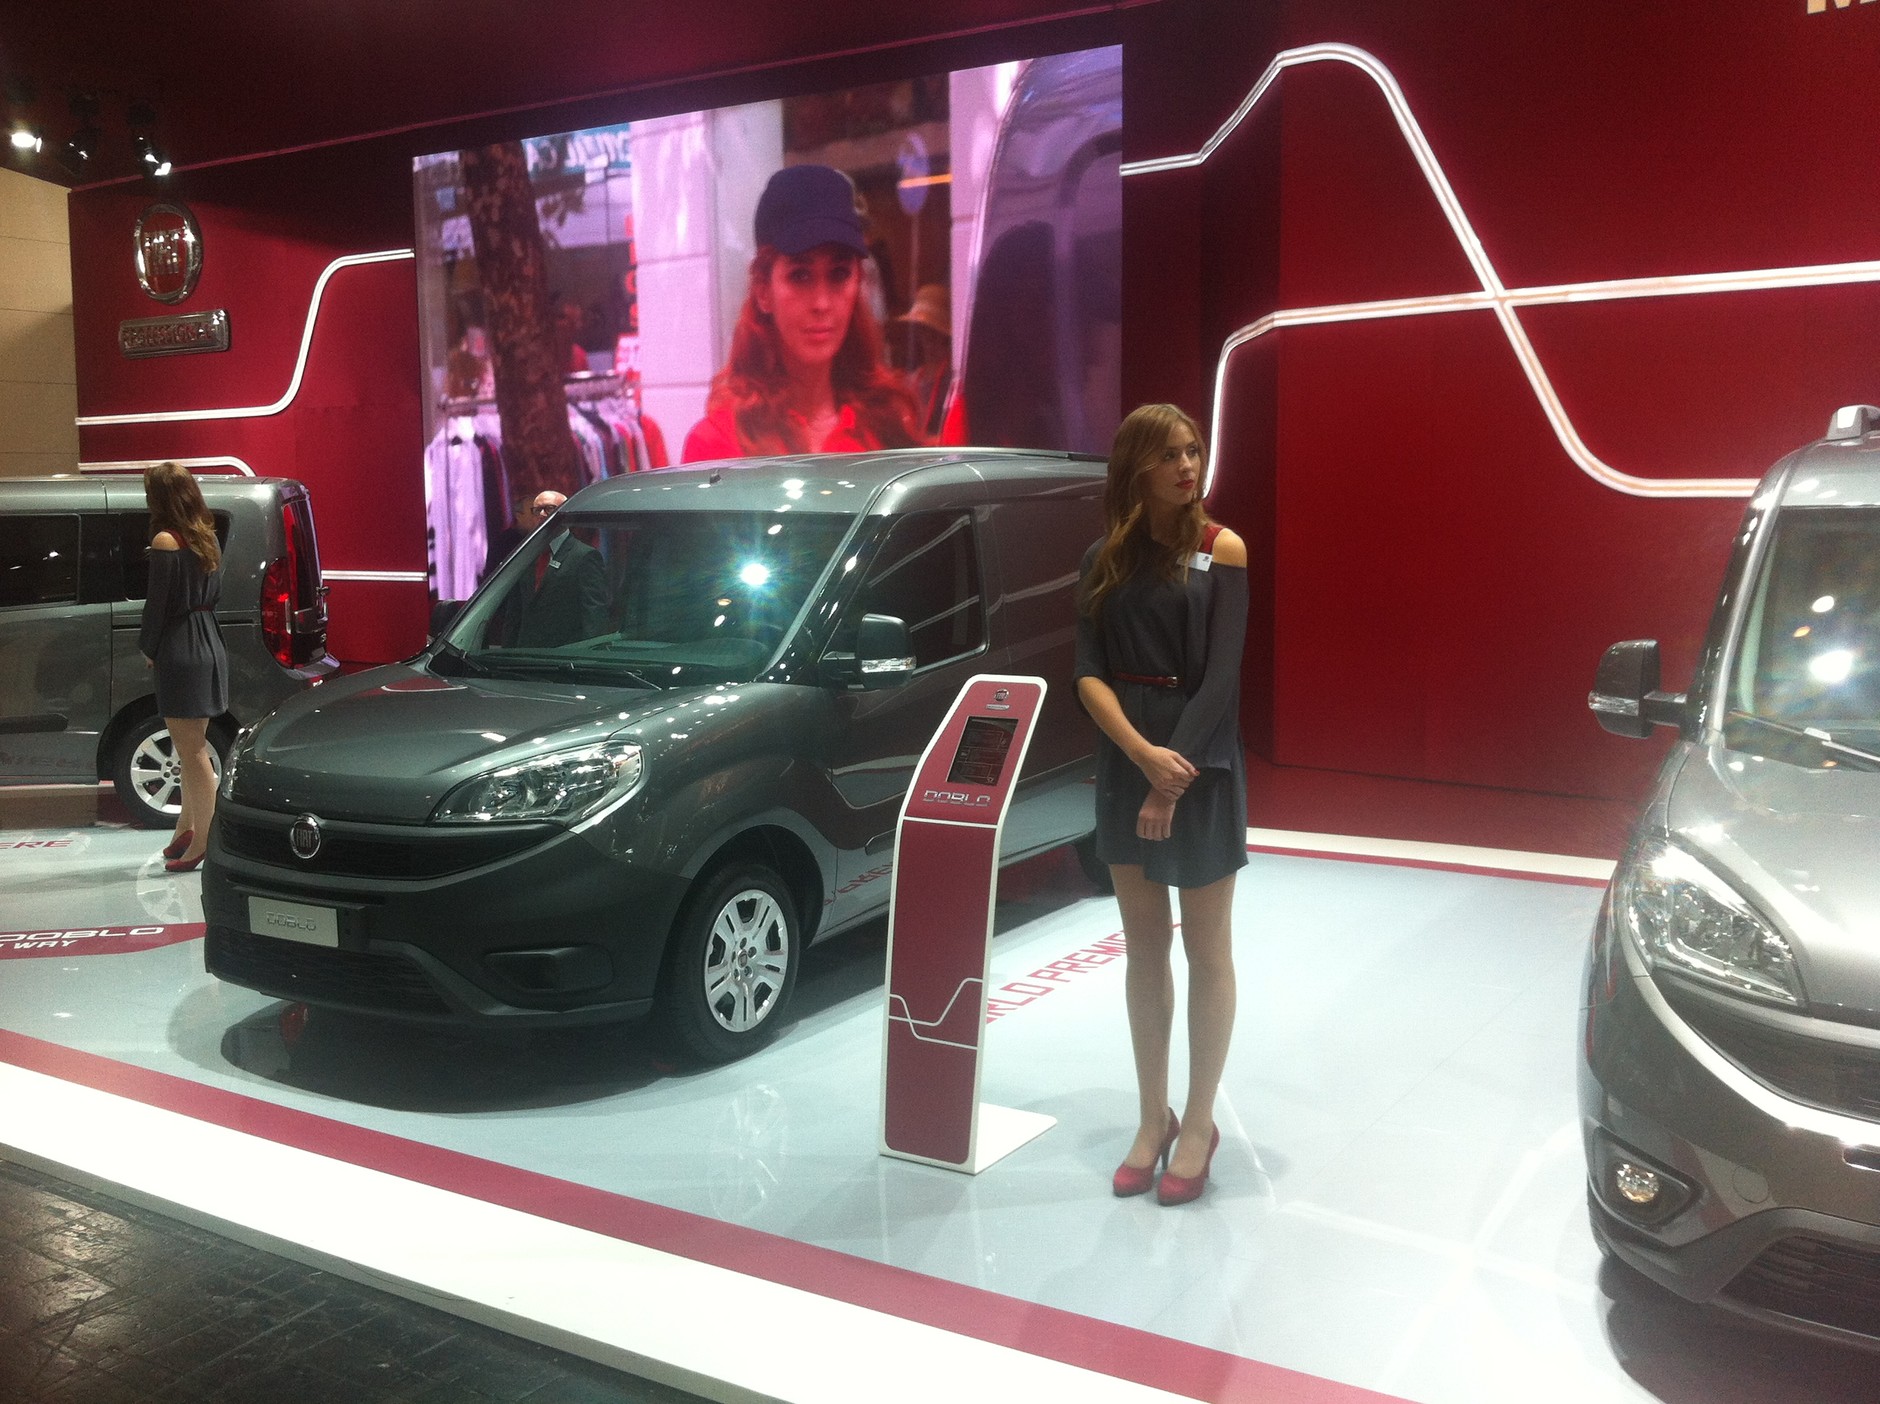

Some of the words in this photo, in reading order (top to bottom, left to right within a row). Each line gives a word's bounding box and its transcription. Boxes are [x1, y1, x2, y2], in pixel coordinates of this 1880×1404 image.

[923, 789, 991, 807] DOBLO
[296, 828, 314, 849] FIAT
[14, 939, 78, 950] WAY
